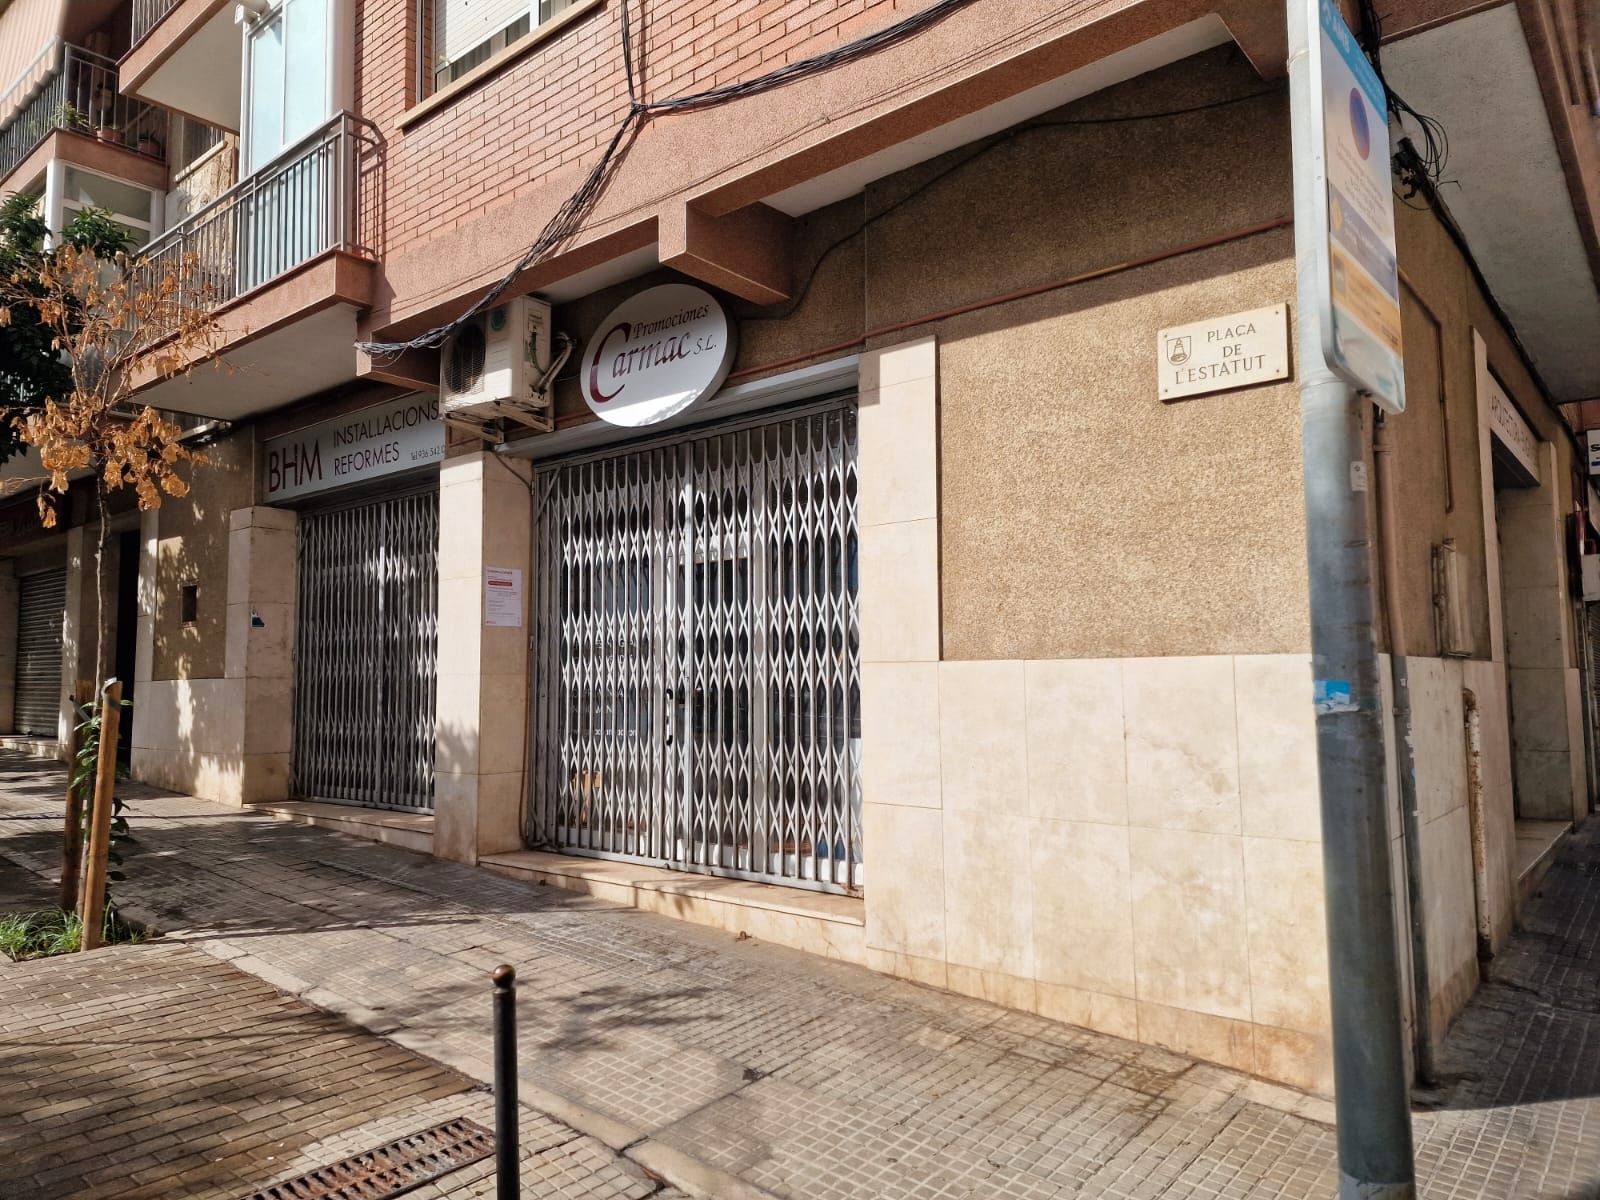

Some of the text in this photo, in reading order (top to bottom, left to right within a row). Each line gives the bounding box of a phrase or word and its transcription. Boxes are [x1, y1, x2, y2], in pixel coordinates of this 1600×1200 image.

[634, 304, 709, 340] Promociones
[1207, 323, 1257, 343] PLAÇA
[590, 322, 717, 404] Carmac S.L.
[1222, 343, 1243, 358] DE
[1175, 354, 1266, 385] L'ESTATUT
[268, 439, 323, 493] BHM
[334, 441, 400, 476] REFORMES
